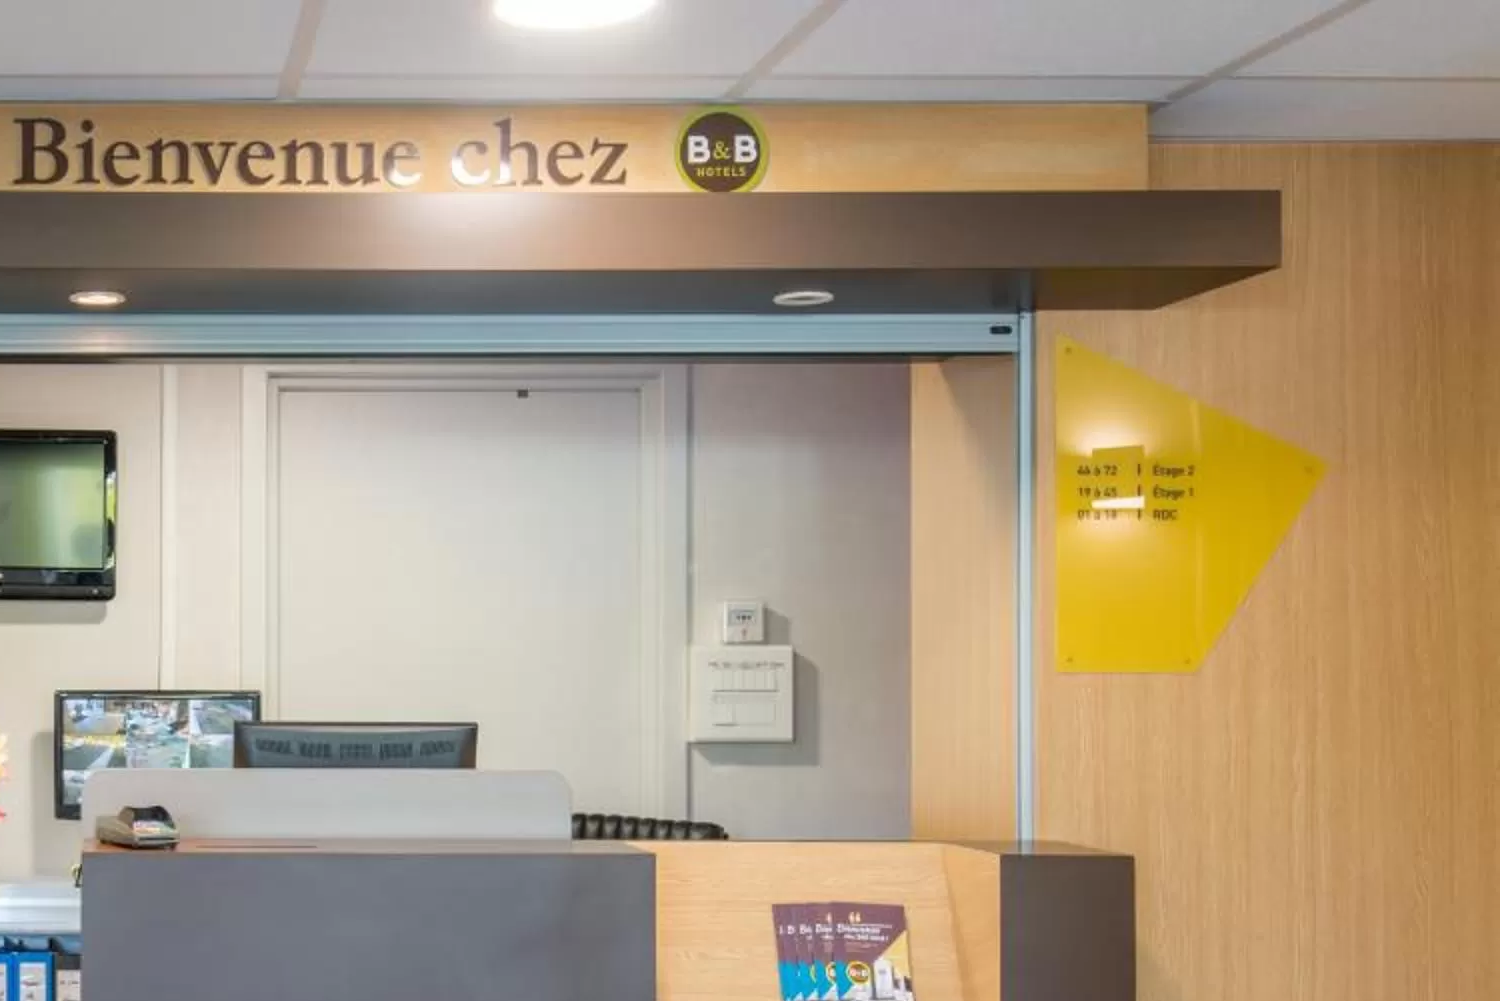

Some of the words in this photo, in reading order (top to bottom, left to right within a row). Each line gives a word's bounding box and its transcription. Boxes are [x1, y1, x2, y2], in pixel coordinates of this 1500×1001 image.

[12, 117, 422, 186] Bienvenue
[450, 116, 629, 186] chez
[687, 134, 758, 164] B&B
[695, 166, 747, 177] HOTELS
[1104, 464, 1118, 476] 72
[1153, 461, 1185, 478] Étage
[1188, 465, 1195, 476] 2
[1153, 484, 1185, 500] Étage
[1153, 509, 1177, 520] RDC
